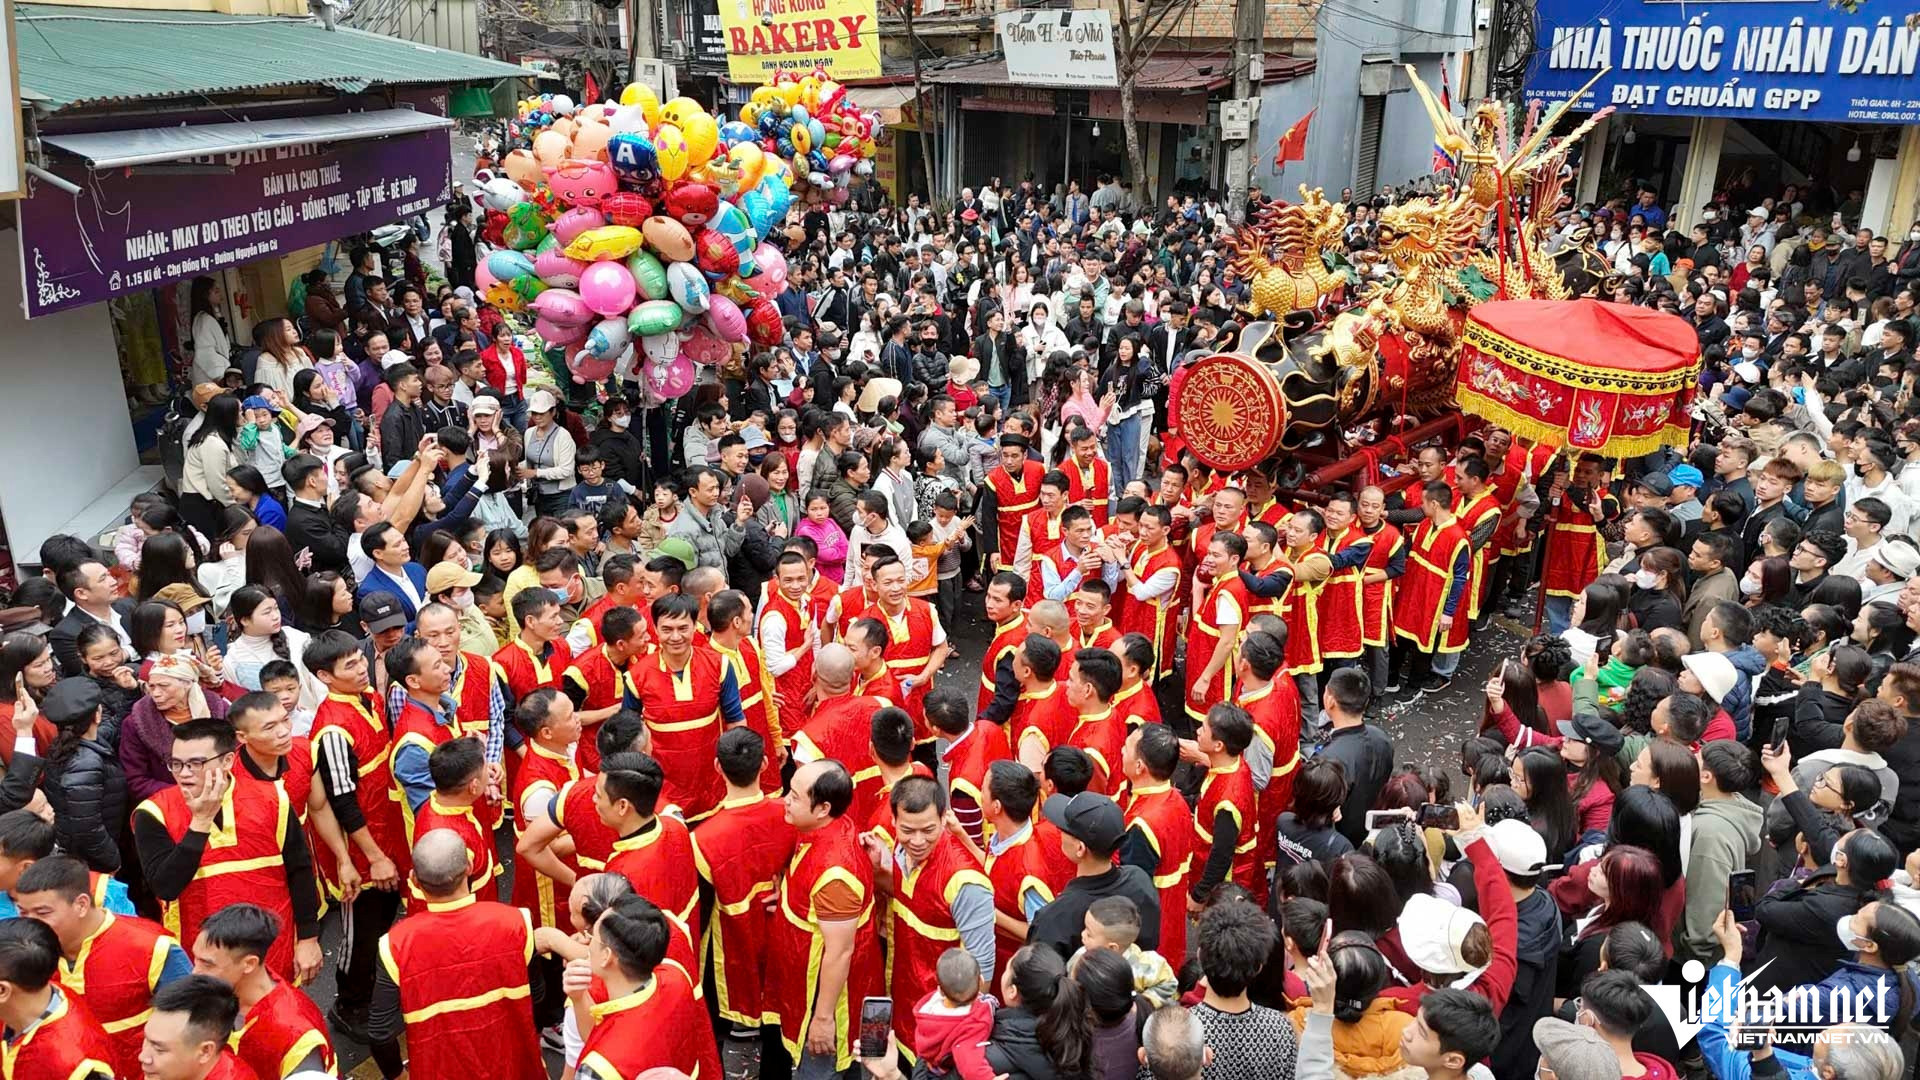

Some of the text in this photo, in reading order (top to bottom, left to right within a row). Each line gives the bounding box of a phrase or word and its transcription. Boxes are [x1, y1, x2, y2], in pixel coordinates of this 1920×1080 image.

[728, 14, 867, 55] BAKERY
[1549, 12, 1920, 75] NHÀ THUỐC NHÂN DÂN
[1611, 77, 1821, 110] ĐẠT CHUẨN GPP
[616, 142, 637, 165] A
[263, 161, 341, 197] BÁN VÀ CHO THUÊ
[125, 229, 170, 262] NHẬN:
[172, 224, 199, 251] MAY
[202, 220, 219, 244] ĐO
[221, 213, 250, 240] THEO
[250, 206, 272, 232] YÊU
[274, 199, 294, 228] CẦU
[301, 194, 327, 222] ĐỒNG
[328, 193, 351, 216] PHỤC
[356, 185, 371, 211] TẬP
[400, 174, 417, 198] TRÁP
